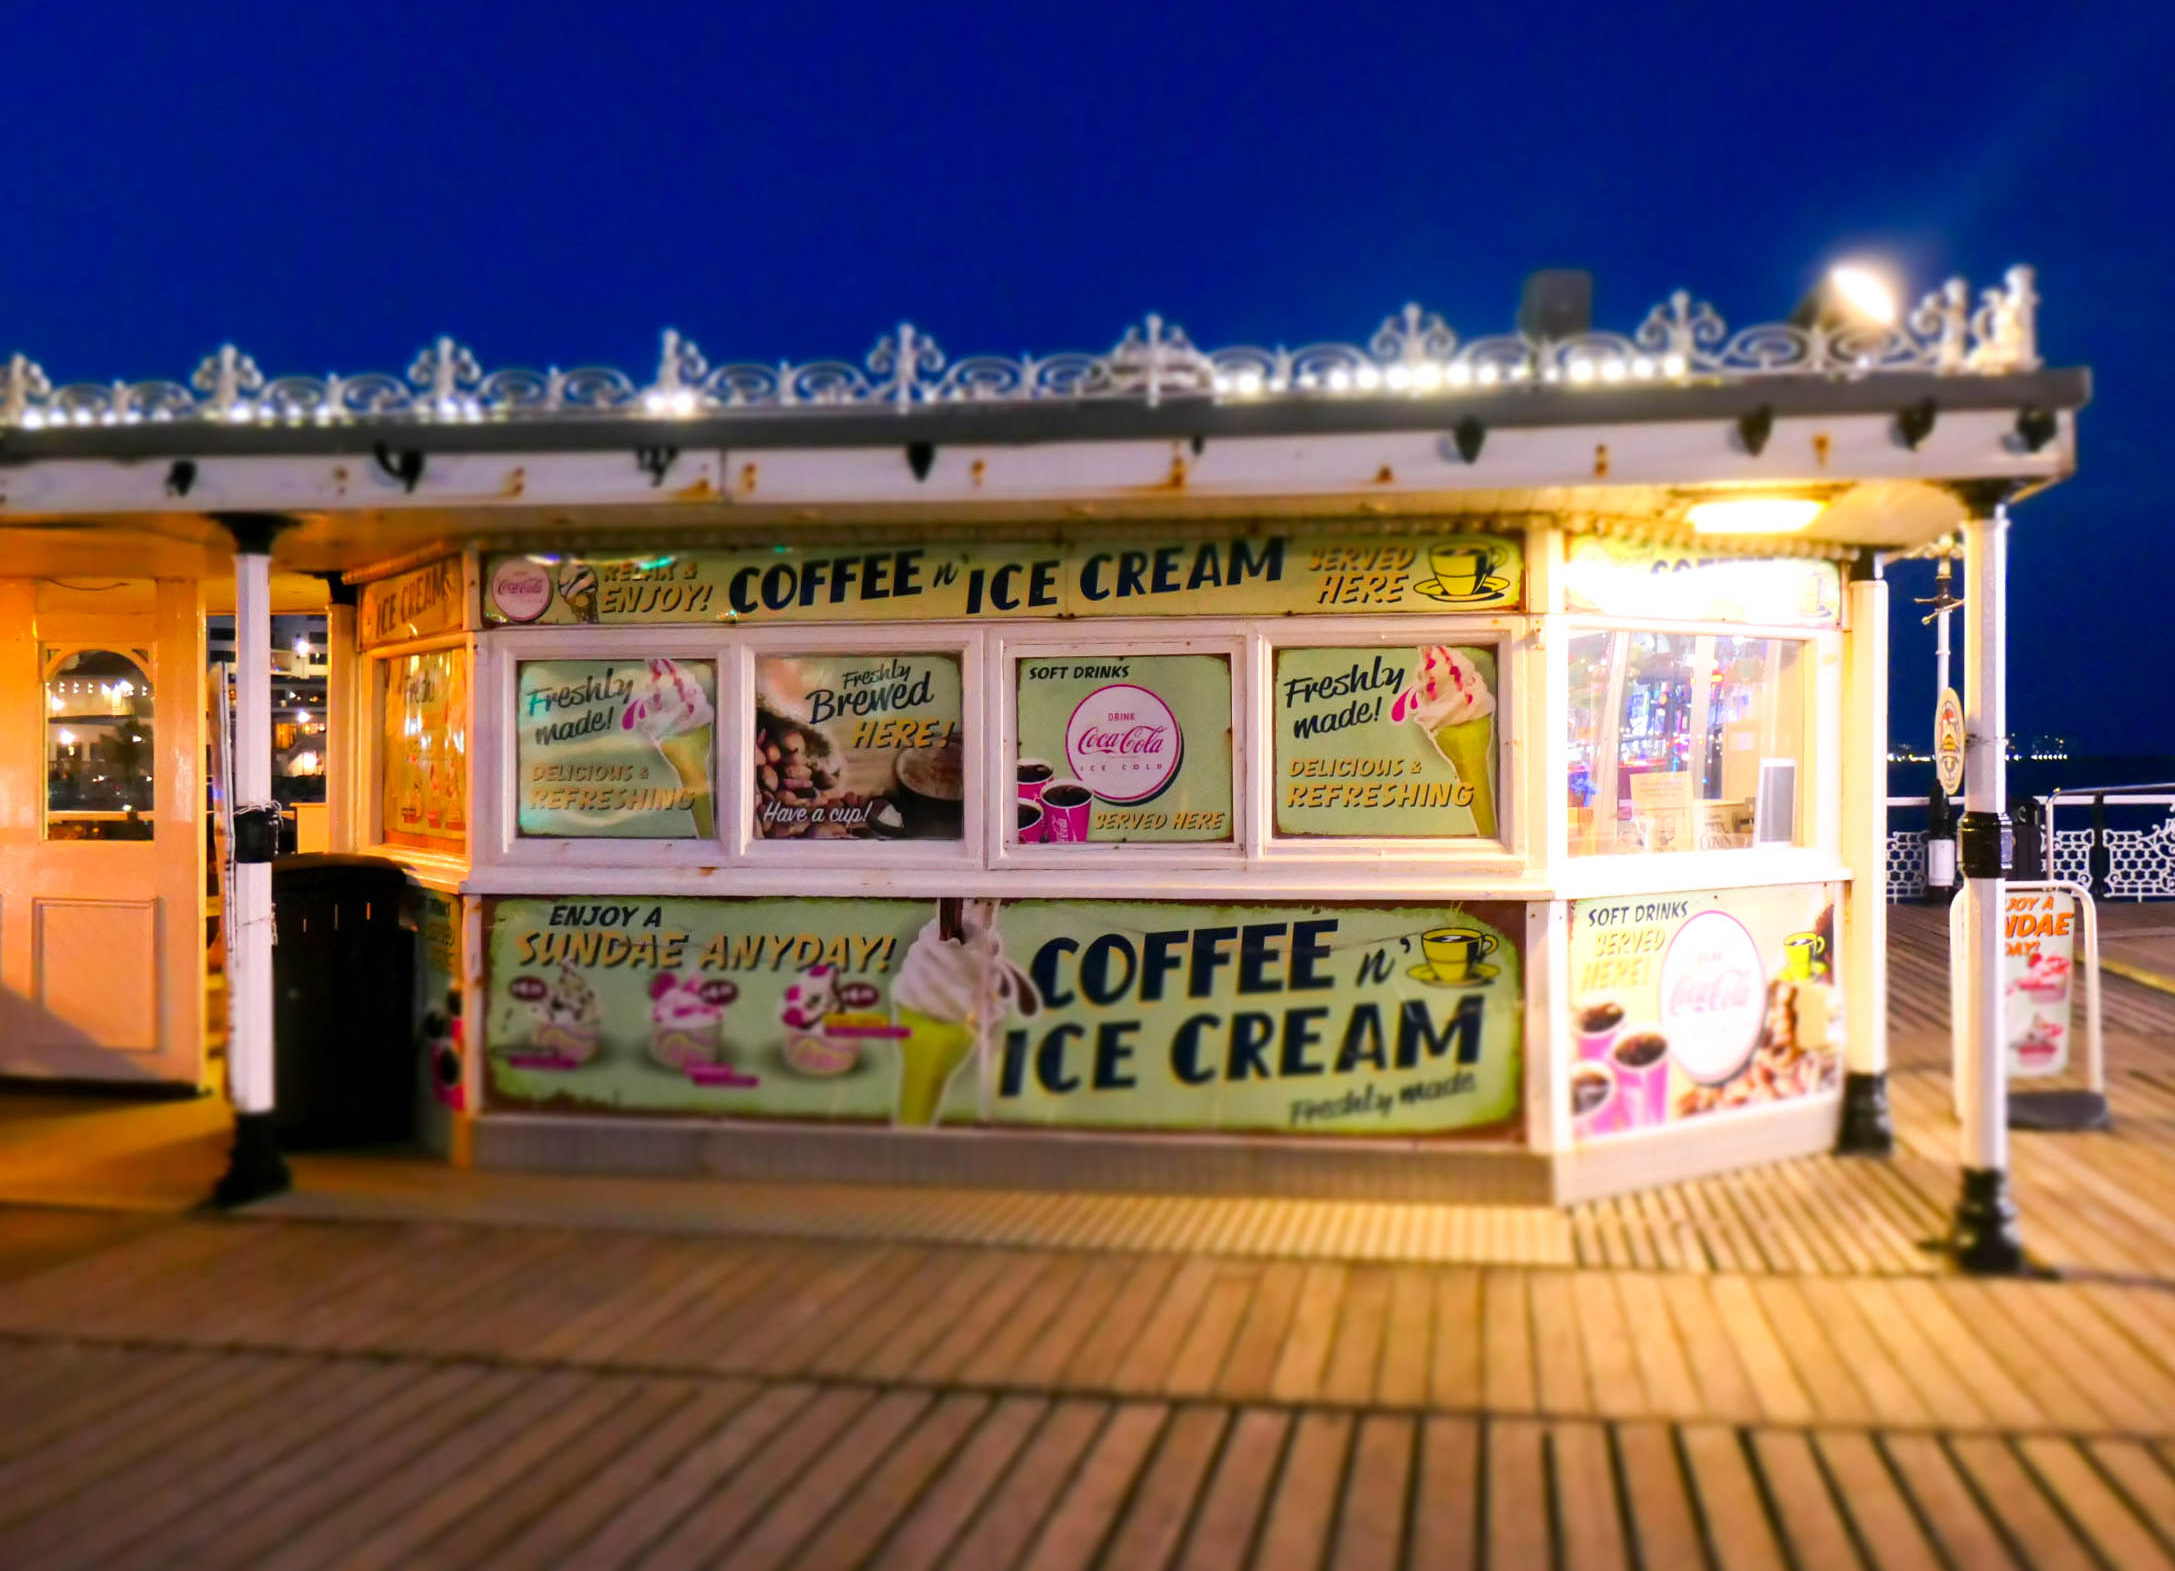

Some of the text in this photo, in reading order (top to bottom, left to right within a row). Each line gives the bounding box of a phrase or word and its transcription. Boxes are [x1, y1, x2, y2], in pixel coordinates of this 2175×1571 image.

[1308, 545, 1417, 571] SERVED
[728, 548, 925, 614] COFFEE
[966, 559, 1062, 615] ICE
[1079, 535, 1292, 601] CREAM
[1317, 574, 1410, 604] HERE
[601, 584, 714, 614] ENJOY!
[376, 593, 397, 639] ICE
[842, 660, 912, 690] Freshly
[1029, 664, 1130, 681] SOFT DRINKS
[1284, 655, 1406, 708] Freshly
[529, 668, 635, 717] Freshly
[805, 672, 935, 724] Brewed
[535, 707, 615, 746] made!
[1108, 712, 1136, 722] DRINK
[1293, 697, 1382, 740] made!
[852, 719, 956, 750] HERE!
[1078, 725, 1167, 755] Coca-Cola
[532, 764, 634, 783] DELICIOUS
[1080, 763, 1163, 772] ICE COLD
[1287, 758, 1423, 778] DELICIOUS &
[528, 787, 696, 812] REFRESHING
[1286, 783, 1475, 809] REFRESHING
[763, 801, 872, 827] Have a cup!
[1095, 810, 1225, 831] SERVED HERE
[549, 905, 662, 928] ENJOY A
[1588, 900, 1689, 927] SOFT DRINKS
[2005, 895, 2055, 913] JOY A
[2005, 912, 2075, 938] NDAE
[517, 931, 898, 973] SUNDAE ANYDAY!
[1596, 929, 1666, 957] SERVED
[1029, 919, 1411, 1009] COFFEE n'
[999, 994, 1485, 1100] ICE CREAM
[1289, 1072, 1476, 1126] Freshly made
